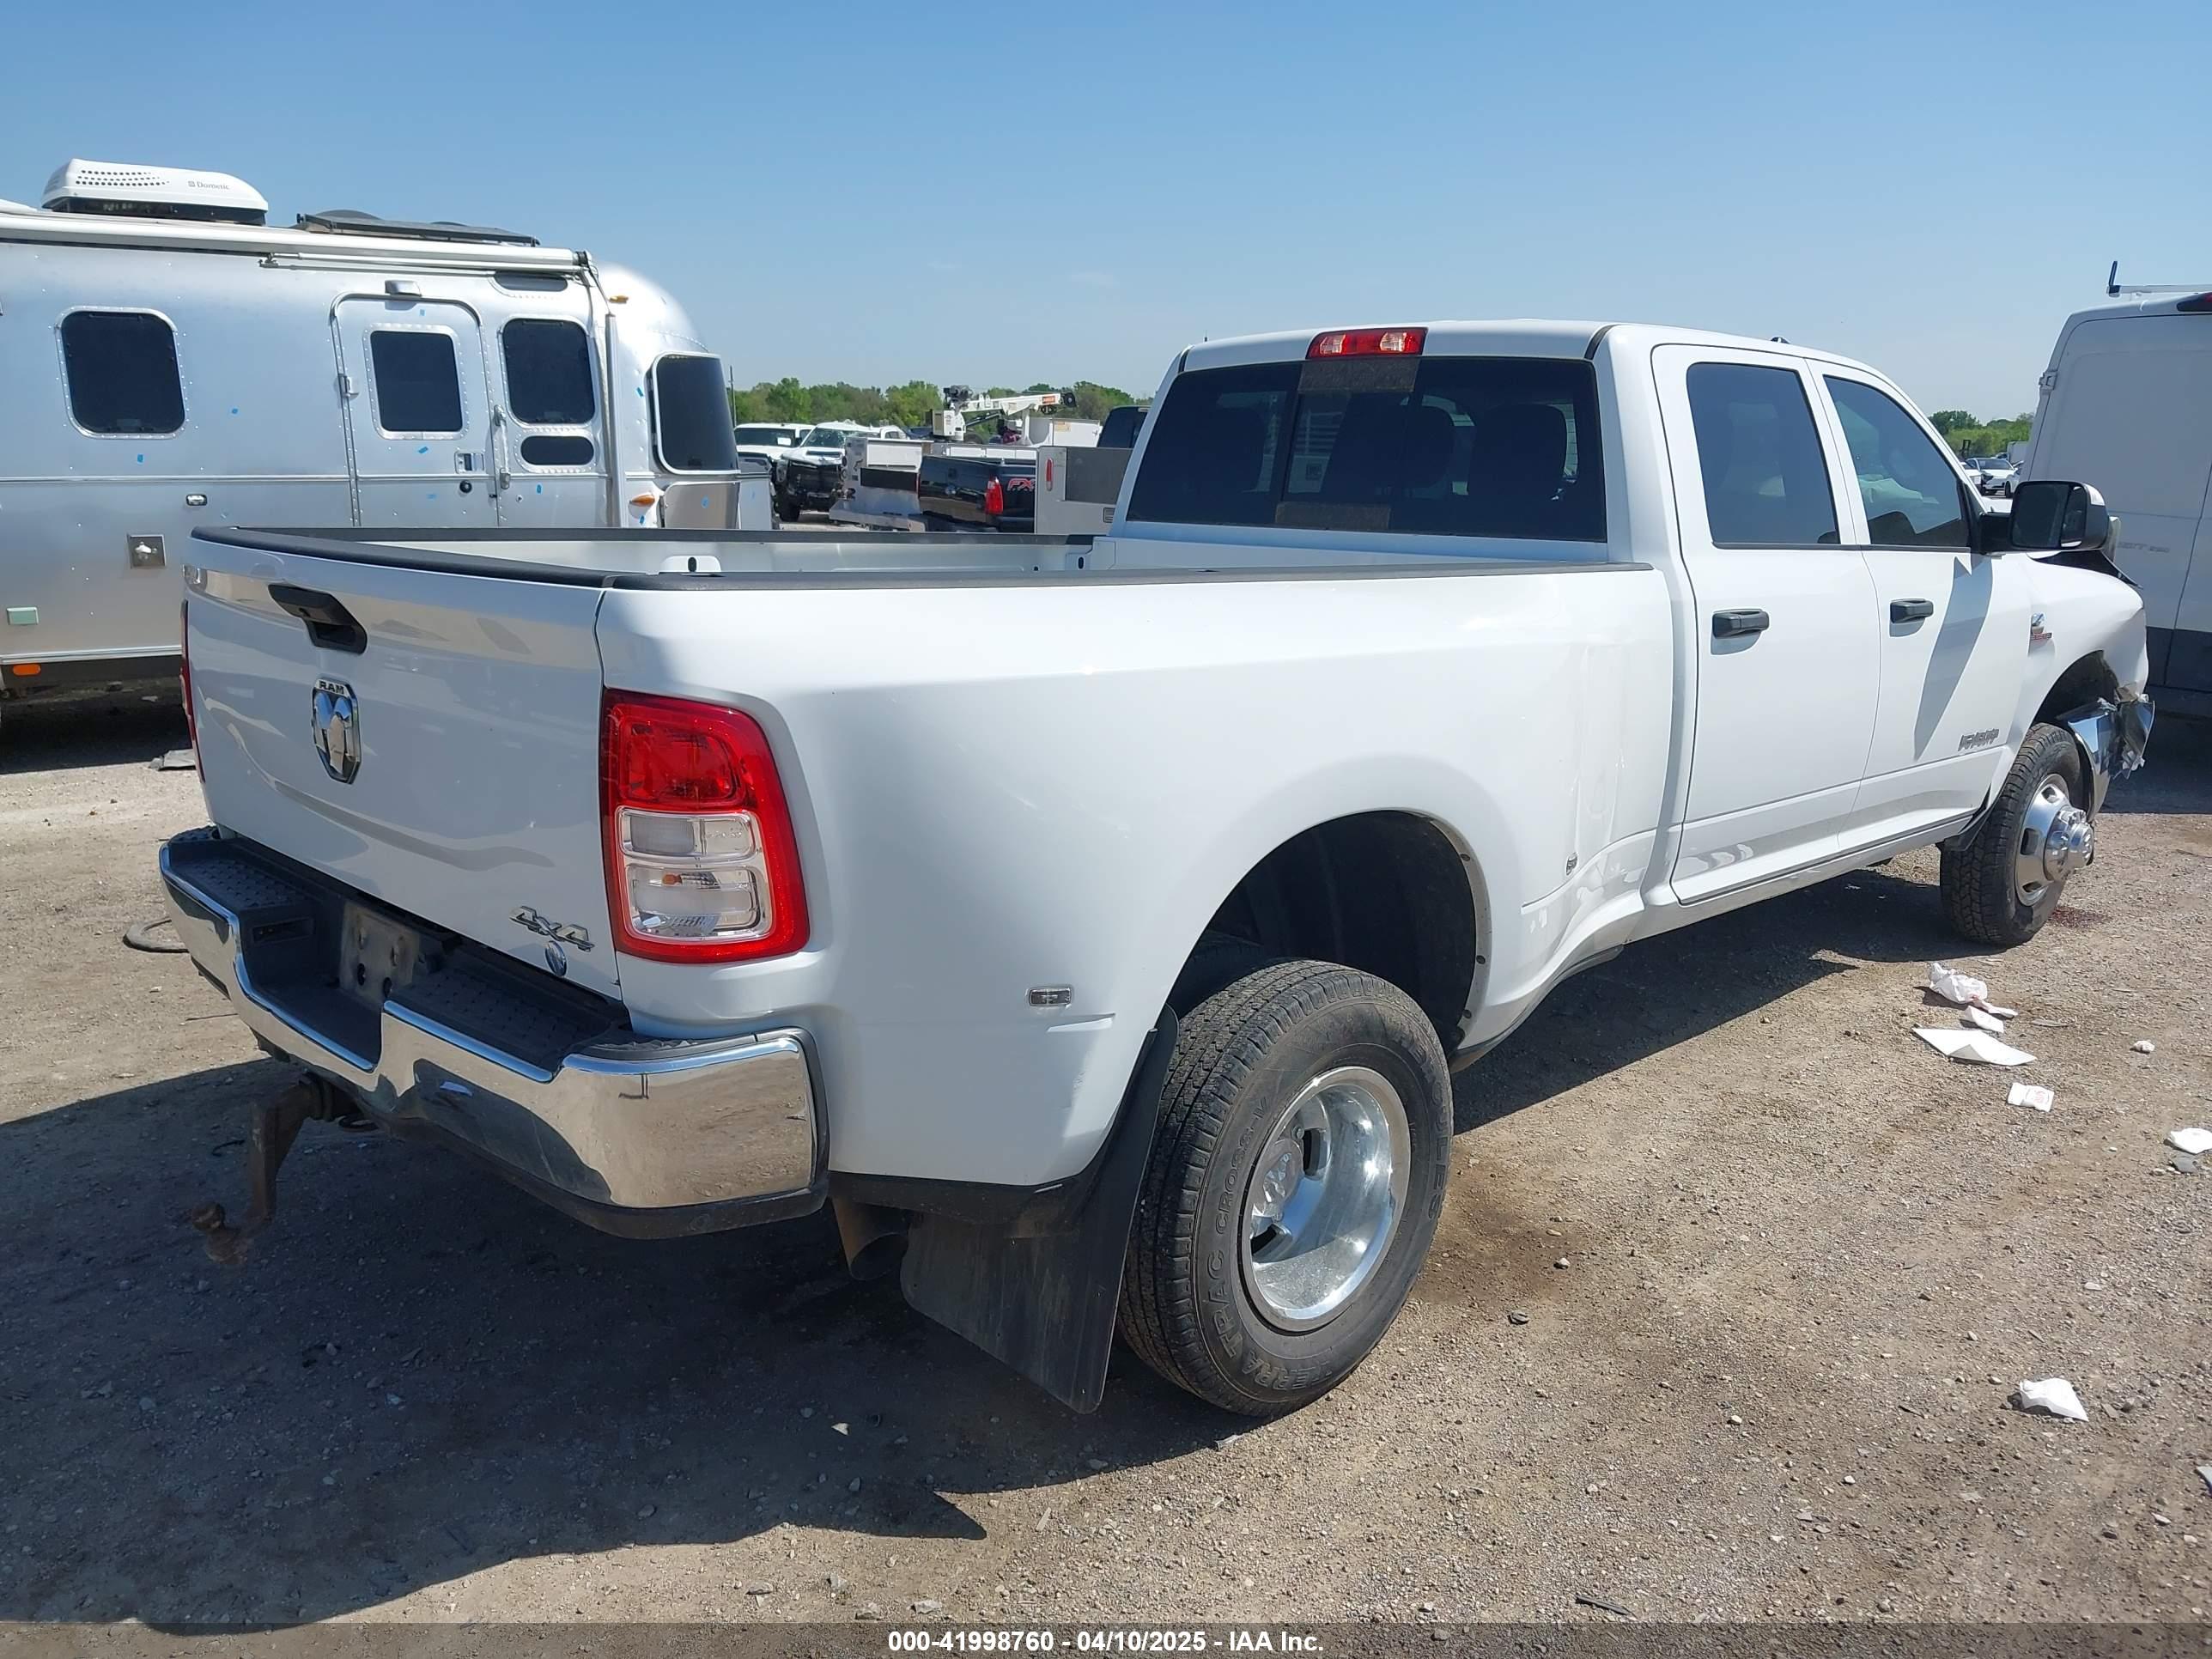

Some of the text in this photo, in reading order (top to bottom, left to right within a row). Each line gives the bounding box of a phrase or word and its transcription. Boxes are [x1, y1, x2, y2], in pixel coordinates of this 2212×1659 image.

[197, 180, 230, 190] Dometic
[318, 680, 345, 695] RAM
[1206, 1249, 1243, 1359] TRAC
